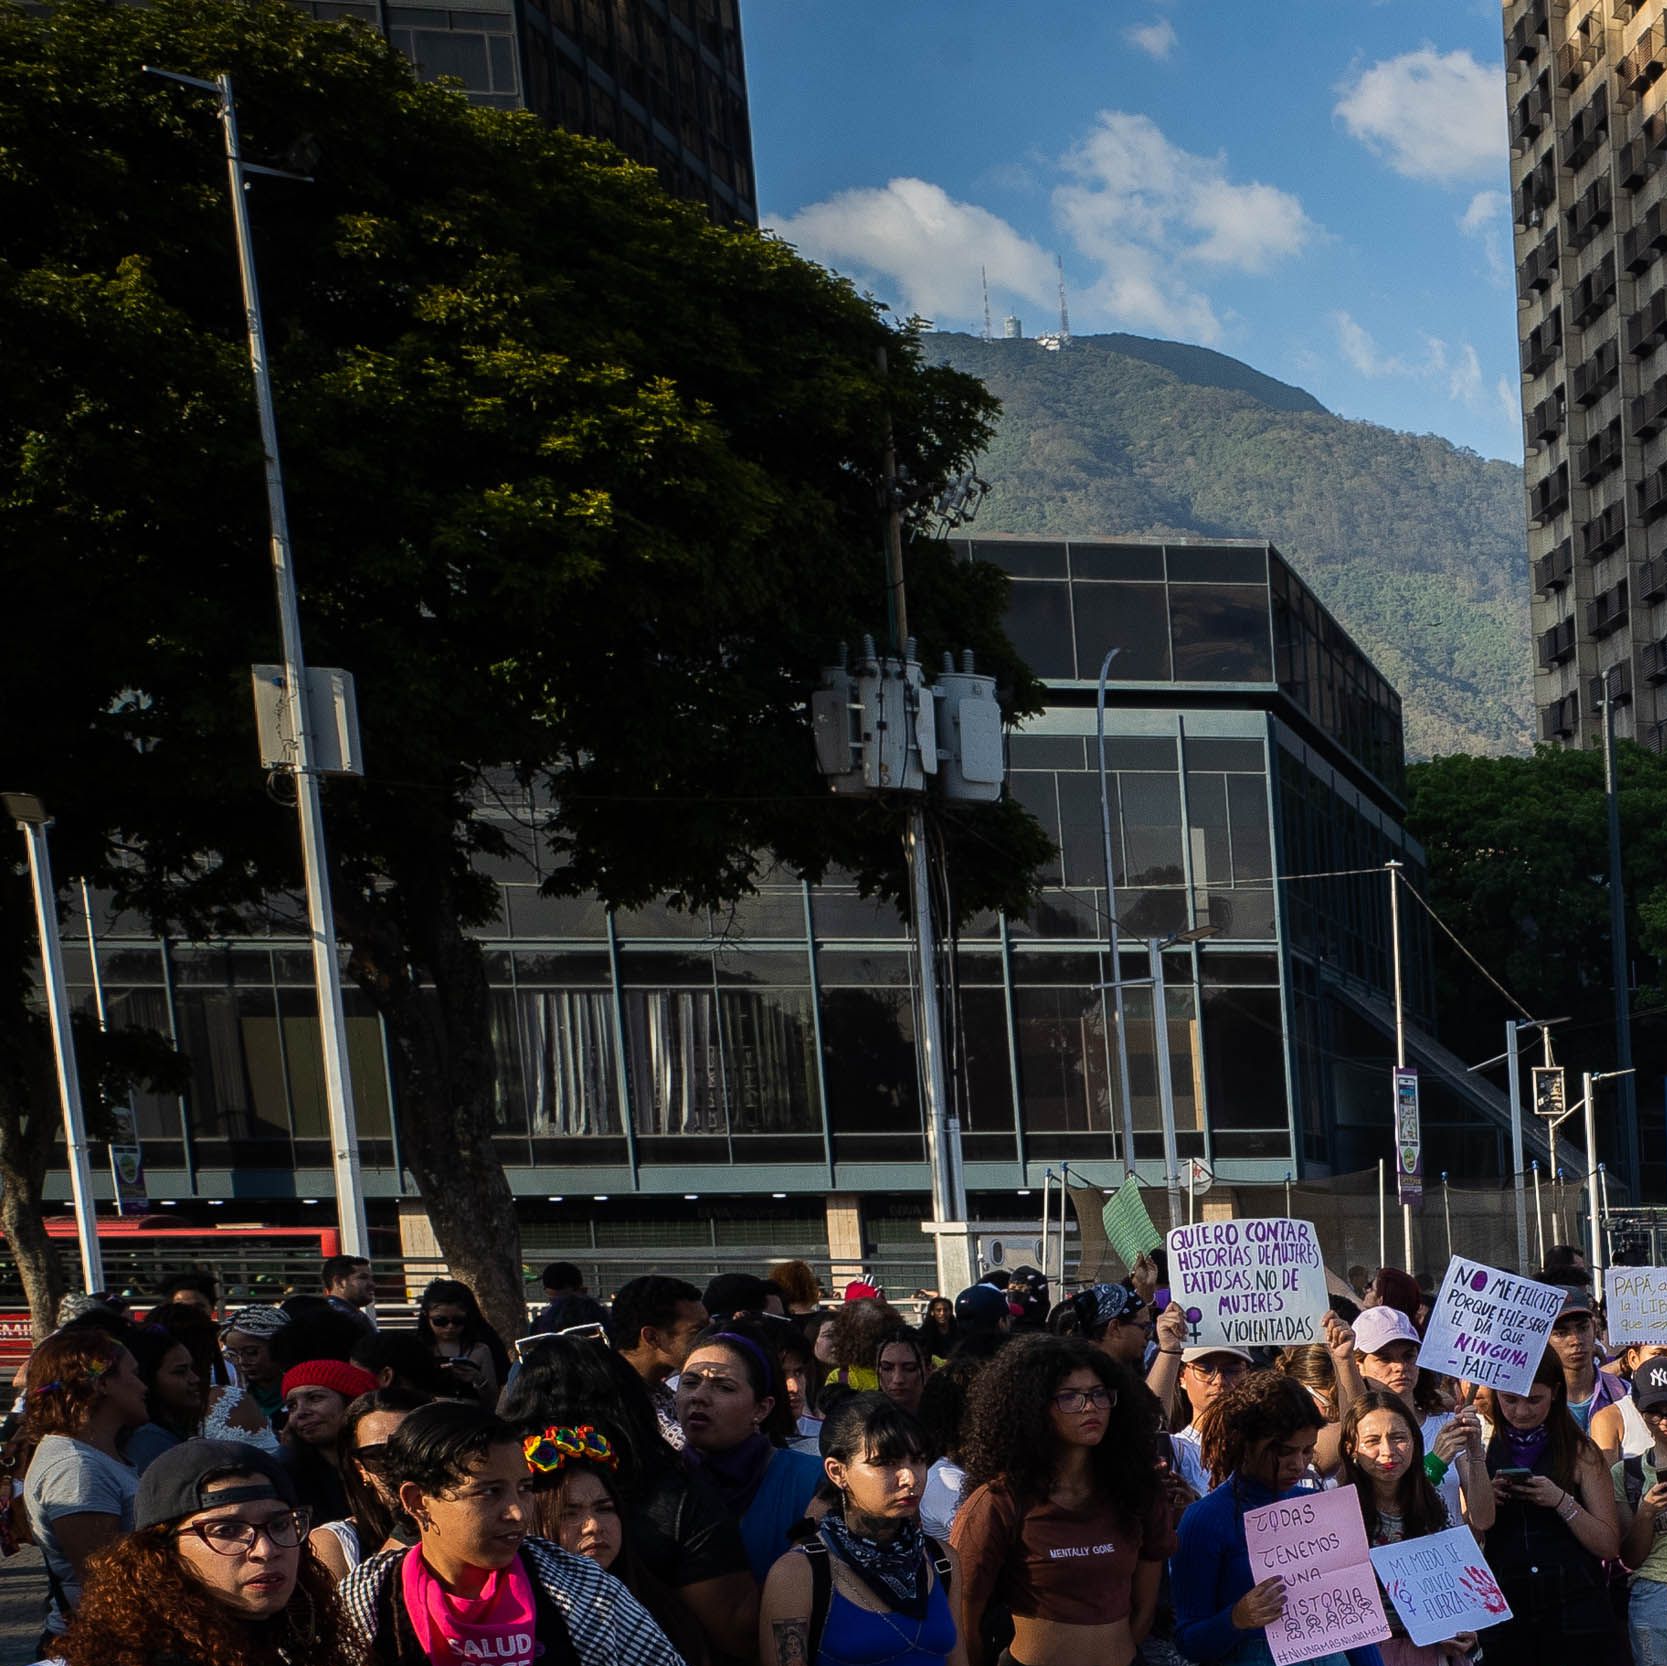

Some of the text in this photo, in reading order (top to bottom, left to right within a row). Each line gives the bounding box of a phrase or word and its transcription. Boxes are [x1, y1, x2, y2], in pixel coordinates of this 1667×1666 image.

[1171, 1221, 1310, 1250] QUIERO CONTAR
[1178, 1246, 1252, 1271] HISTORIAS
[1256, 1268, 1299, 1291] NO DE
[1454, 1266, 1514, 1300] NO ME
[1219, 1291, 1284, 1315] MUJERES
[1447, 1289, 1497, 1319] PORQUE
[1220, 1316, 1314, 1342] VIOLENTADAS
[1451, 1310, 1525, 1345] EL QUE
[1454, 1333, 1528, 1369] NINGUNA
[1252, 1504, 1315, 1532] TODAS
[1050, 1547, 1089, 1558] MENTALLY
[1257, 1533, 1340, 1568] TENEMOS
[1409, 1543, 1462, 1573] MIEDO SE
[1284, 1567, 1321, 1587] UNA
[1423, 1590, 1469, 1621] FUERZA
[447, 1633, 531, 1658] SALUD
